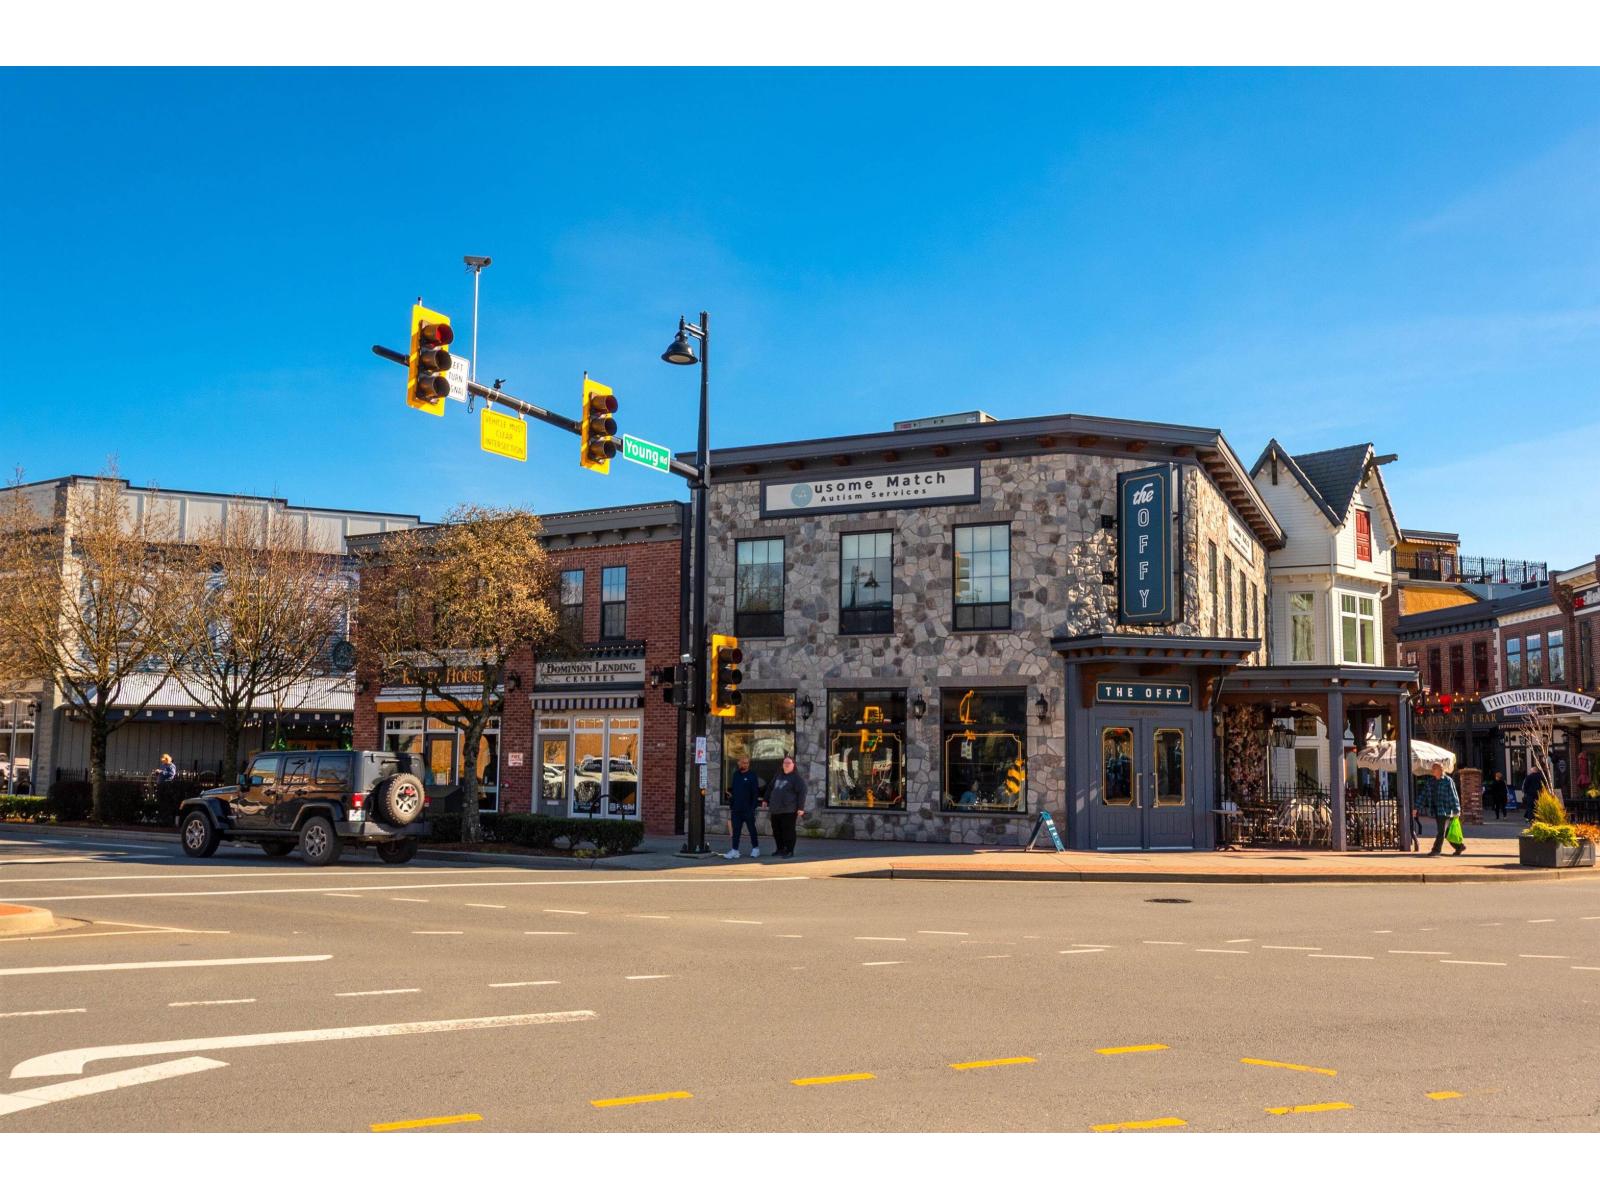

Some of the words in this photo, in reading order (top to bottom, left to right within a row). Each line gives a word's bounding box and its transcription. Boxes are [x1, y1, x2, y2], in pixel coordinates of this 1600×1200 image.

[452, 361, 464, 372] EFT
[450, 385, 464, 396] GNAL
[626, 439, 659, 466] Young
[814, 480, 873, 494] usome
[886, 472, 946, 488] Match
[820, 493, 862, 503] Autism
[871, 488, 927, 498] Services
[1132, 483, 1154, 506] the
[1137, 508, 1150, 608] OFFY
[445, 668, 485, 683] HOUSE
[547, 663, 592, 674] DOMINION
[595, 662, 636, 672] LENDING
[1105, 687, 1133, 697] THE
[1145, 688, 1182, 699] OFFY
[1485, 691, 1560, 709] THUNDERBIRD
[1564, 693, 1592, 710] LANE
[1454, 714, 1477, 724] WIE
[1479, 713, 1497, 722] BAR
